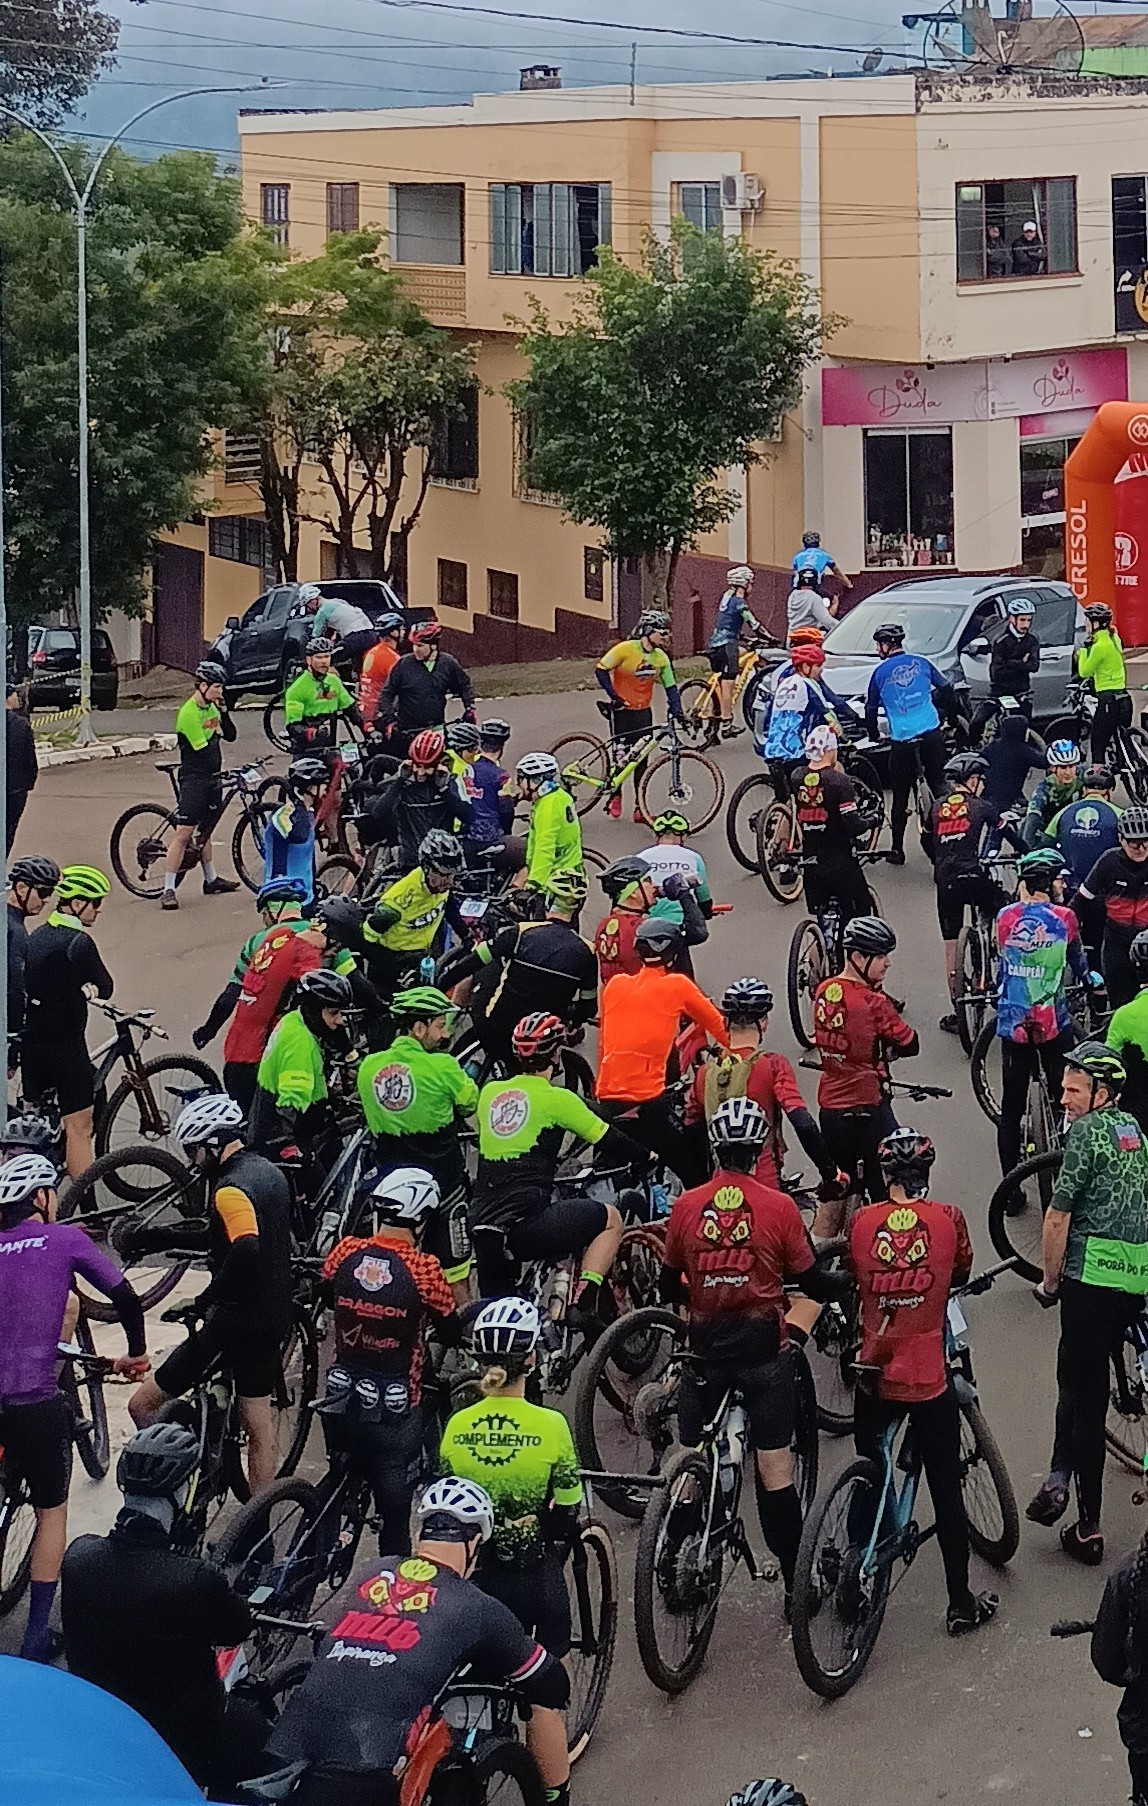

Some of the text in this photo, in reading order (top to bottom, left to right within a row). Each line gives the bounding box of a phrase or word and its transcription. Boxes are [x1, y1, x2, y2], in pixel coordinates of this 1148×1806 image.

[868, 385, 942, 418] Duda
[1033, 374, 1085, 406] Duda
[1070, 499, 1088, 599] CRESOL
[453, 1432, 542, 1447] COMPLEMENTO
